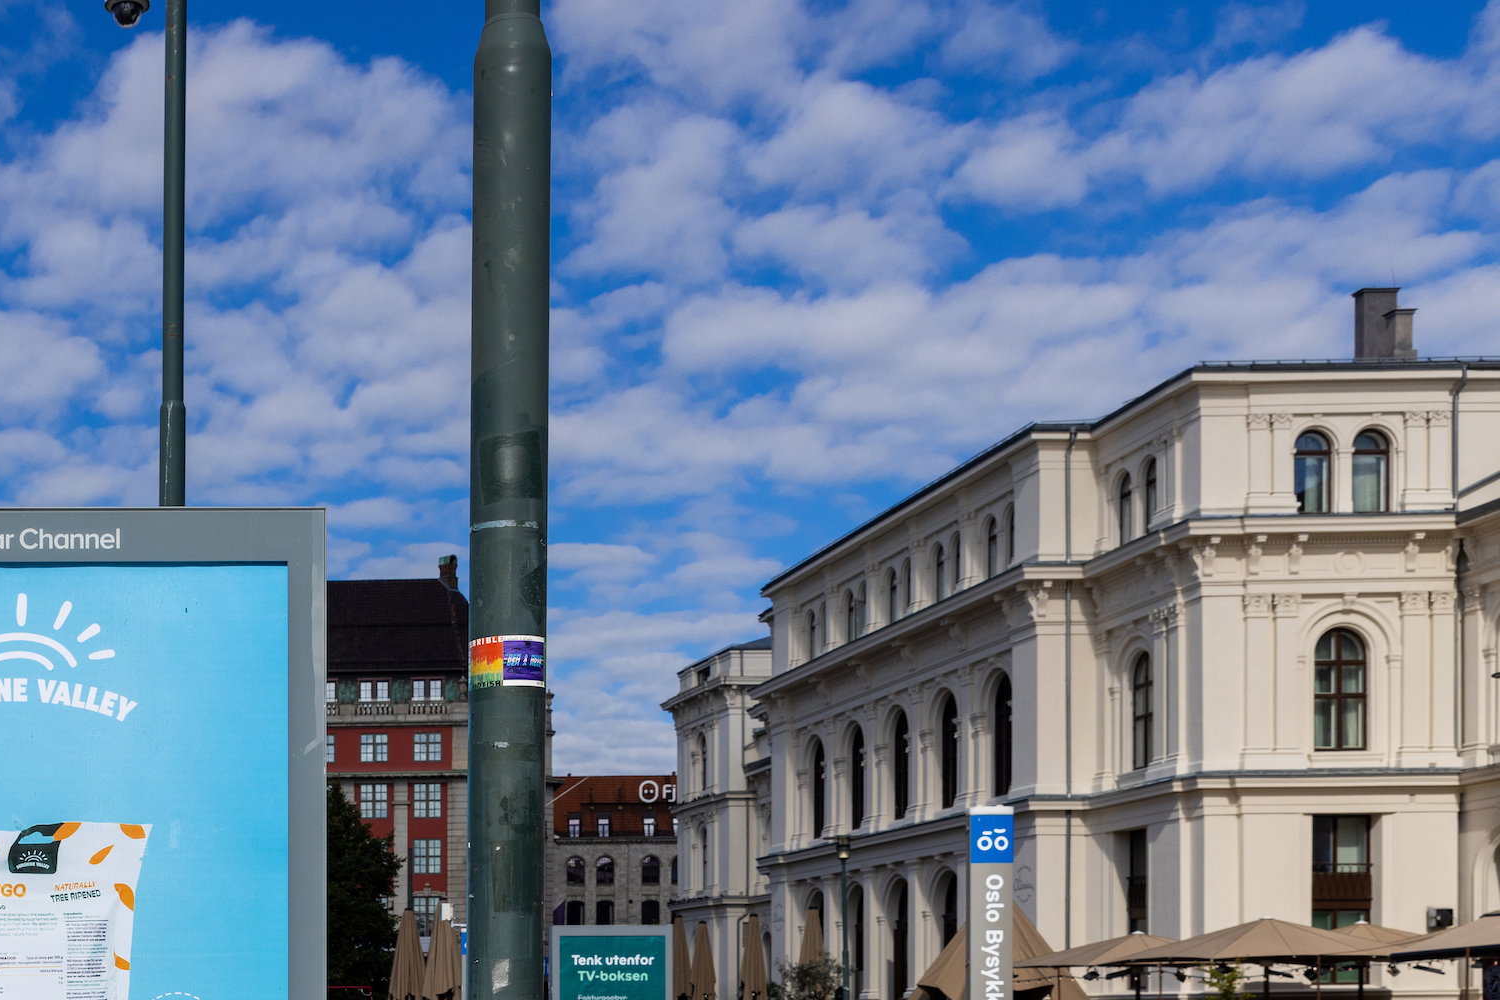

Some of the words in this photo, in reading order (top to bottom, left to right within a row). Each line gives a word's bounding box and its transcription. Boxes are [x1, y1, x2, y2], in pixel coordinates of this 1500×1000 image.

[19, 527, 121, 550] Channel
[37, 678, 138, 722] VALLEY
[54, 881, 97, 891] NATURALLY
[50, 893, 69, 902] TREE
[70, 889, 101, 901] RIPENED
[985, 874, 1004, 923] Oslo
[571, 954, 603, 966] Tenk
[605, 954, 655, 966] utenfor
[577, 970, 649, 982] TV-boksen
